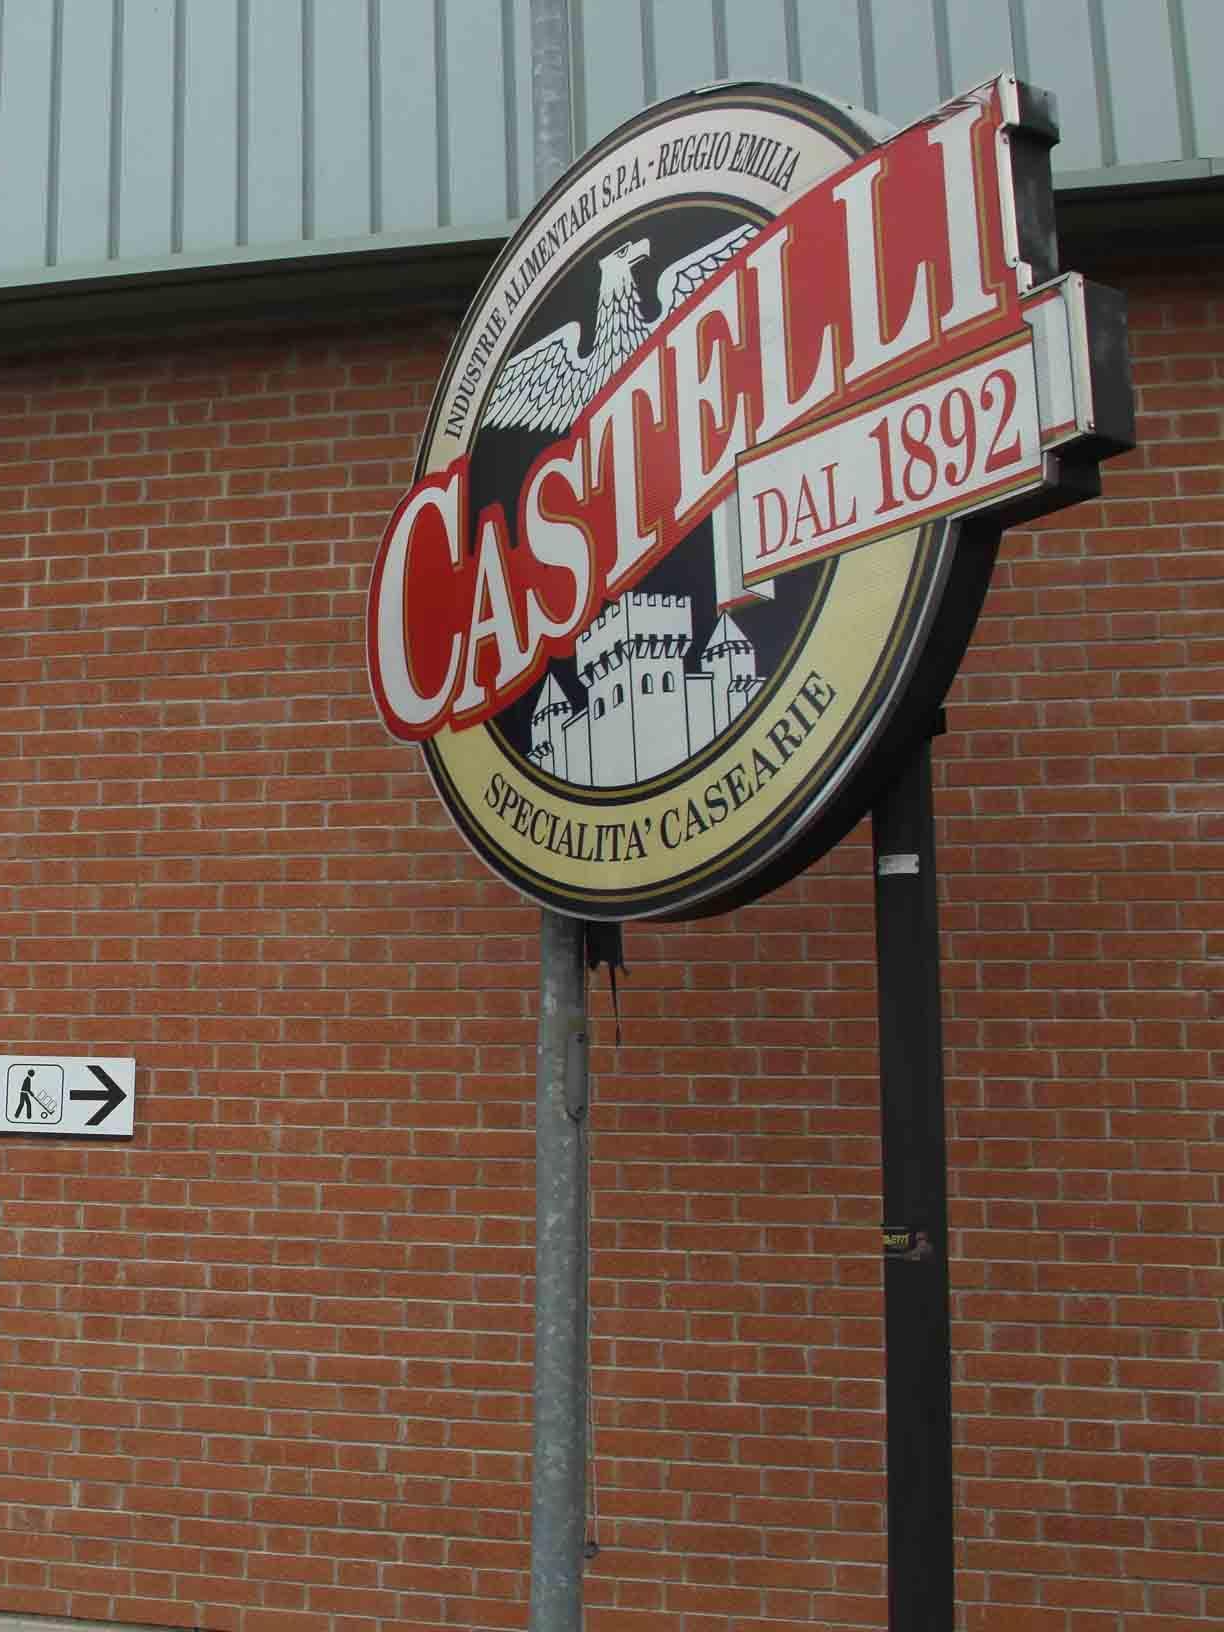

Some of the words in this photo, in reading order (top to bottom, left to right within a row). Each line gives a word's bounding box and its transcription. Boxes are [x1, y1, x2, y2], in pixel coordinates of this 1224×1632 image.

[445, 307, 508, 440] INDUSTRIE
[501, 186, 599, 314] ALIMENTARI
[656, 131, 732, 180] REGGIO
[727, 132, 801, 192] EMILIA
[376, 100, 999, 724] CASTELLI
[752, 462, 857, 559] DAL
[869, 368, 1023, 515] 1892
[659, 669, 839, 850] CASEARIE
